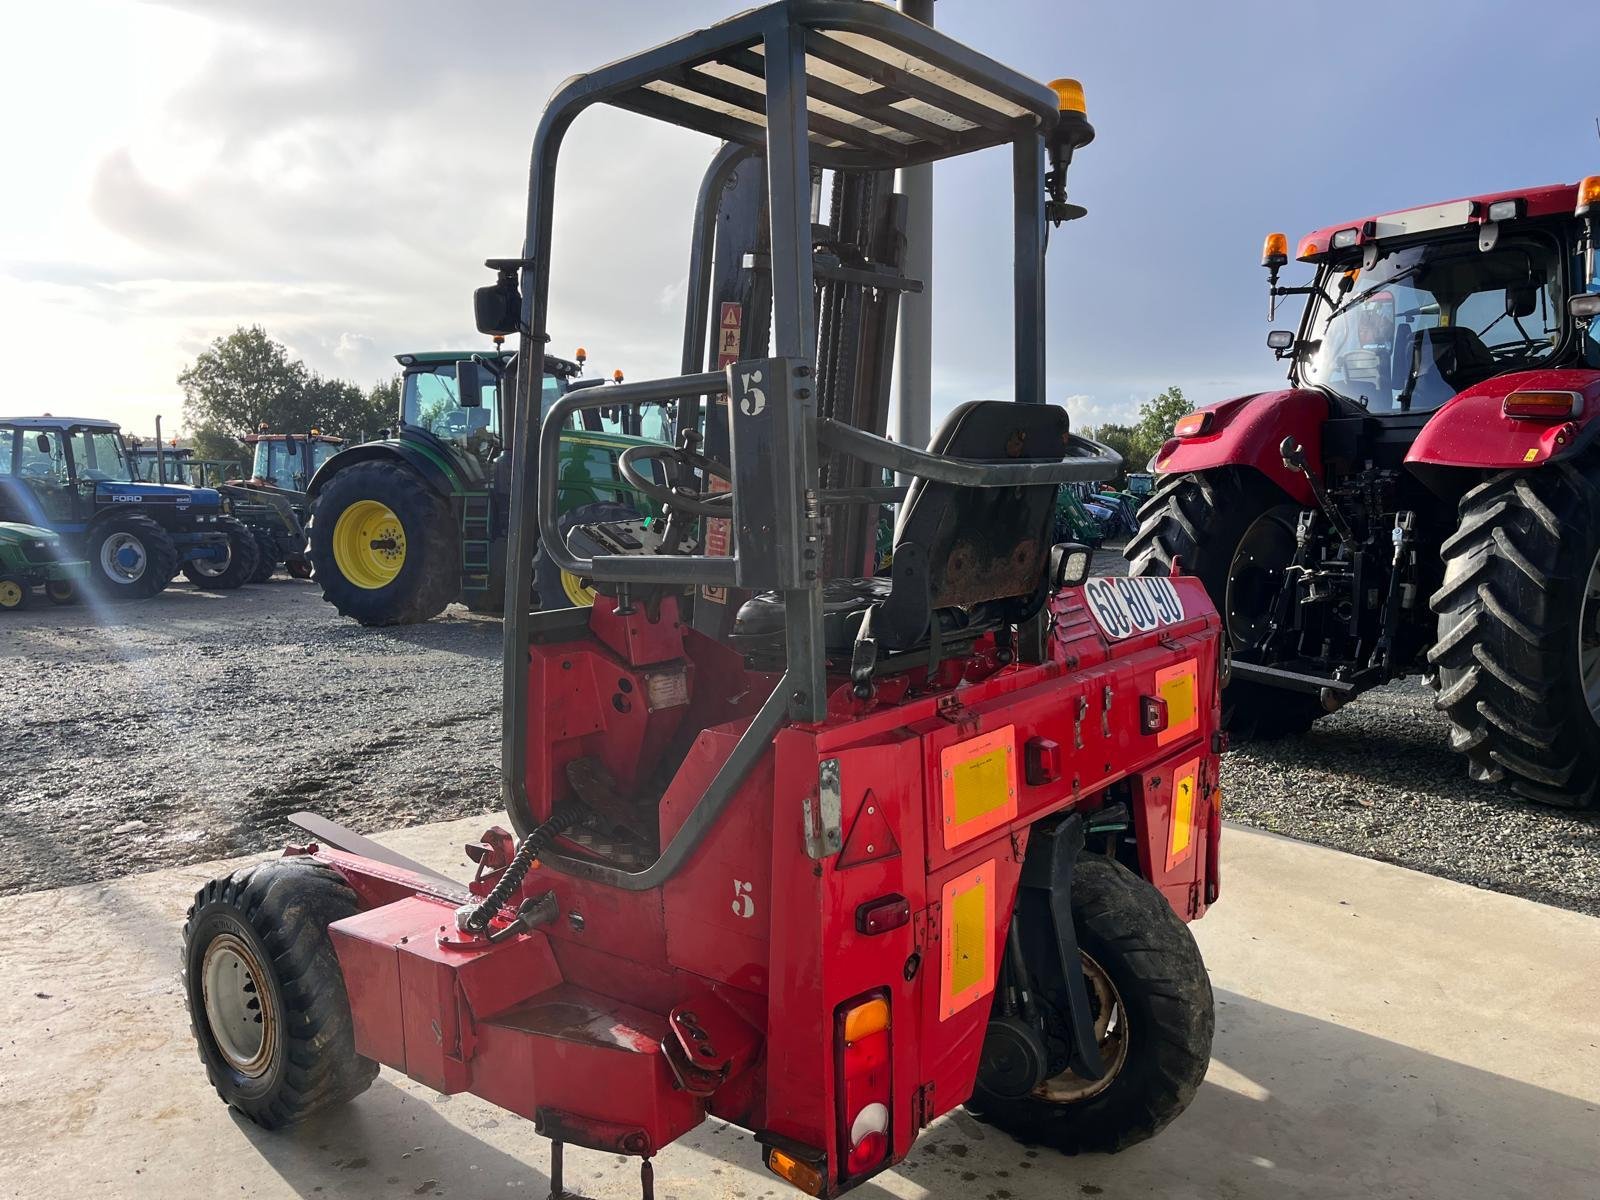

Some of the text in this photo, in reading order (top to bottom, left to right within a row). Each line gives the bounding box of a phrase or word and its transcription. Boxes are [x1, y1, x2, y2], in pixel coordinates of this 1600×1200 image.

[740, 370, 766, 416] 5
[1087, 577, 1181, 636] 60 80 90
[732, 879, 755, 918] 5
